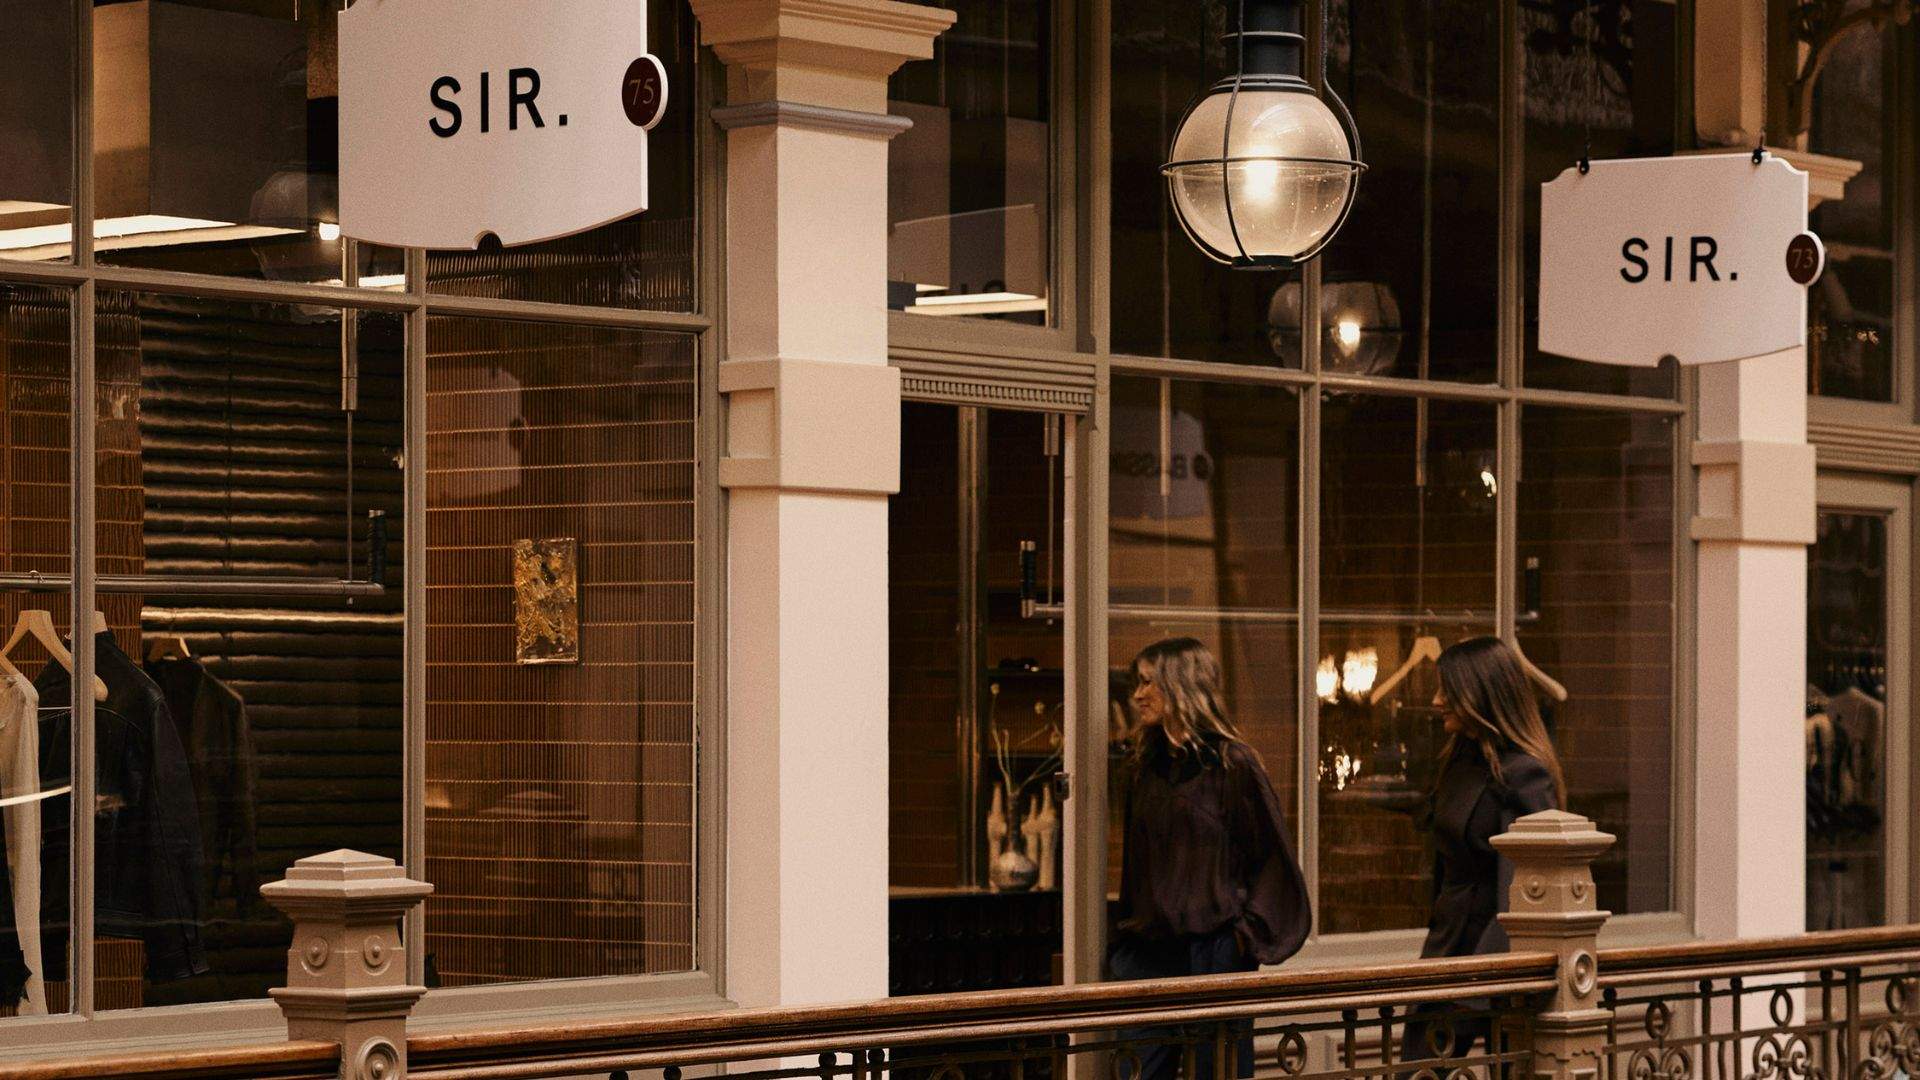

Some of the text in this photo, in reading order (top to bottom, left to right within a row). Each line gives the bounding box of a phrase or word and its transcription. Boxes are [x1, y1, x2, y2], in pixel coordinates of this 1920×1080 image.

[429, 67, 568, 138] SIR.
[628, 78, 655, 106] 75
[1620, 236, 1738, 283] SIR.
[1792, 247, 1814, 269] 73
